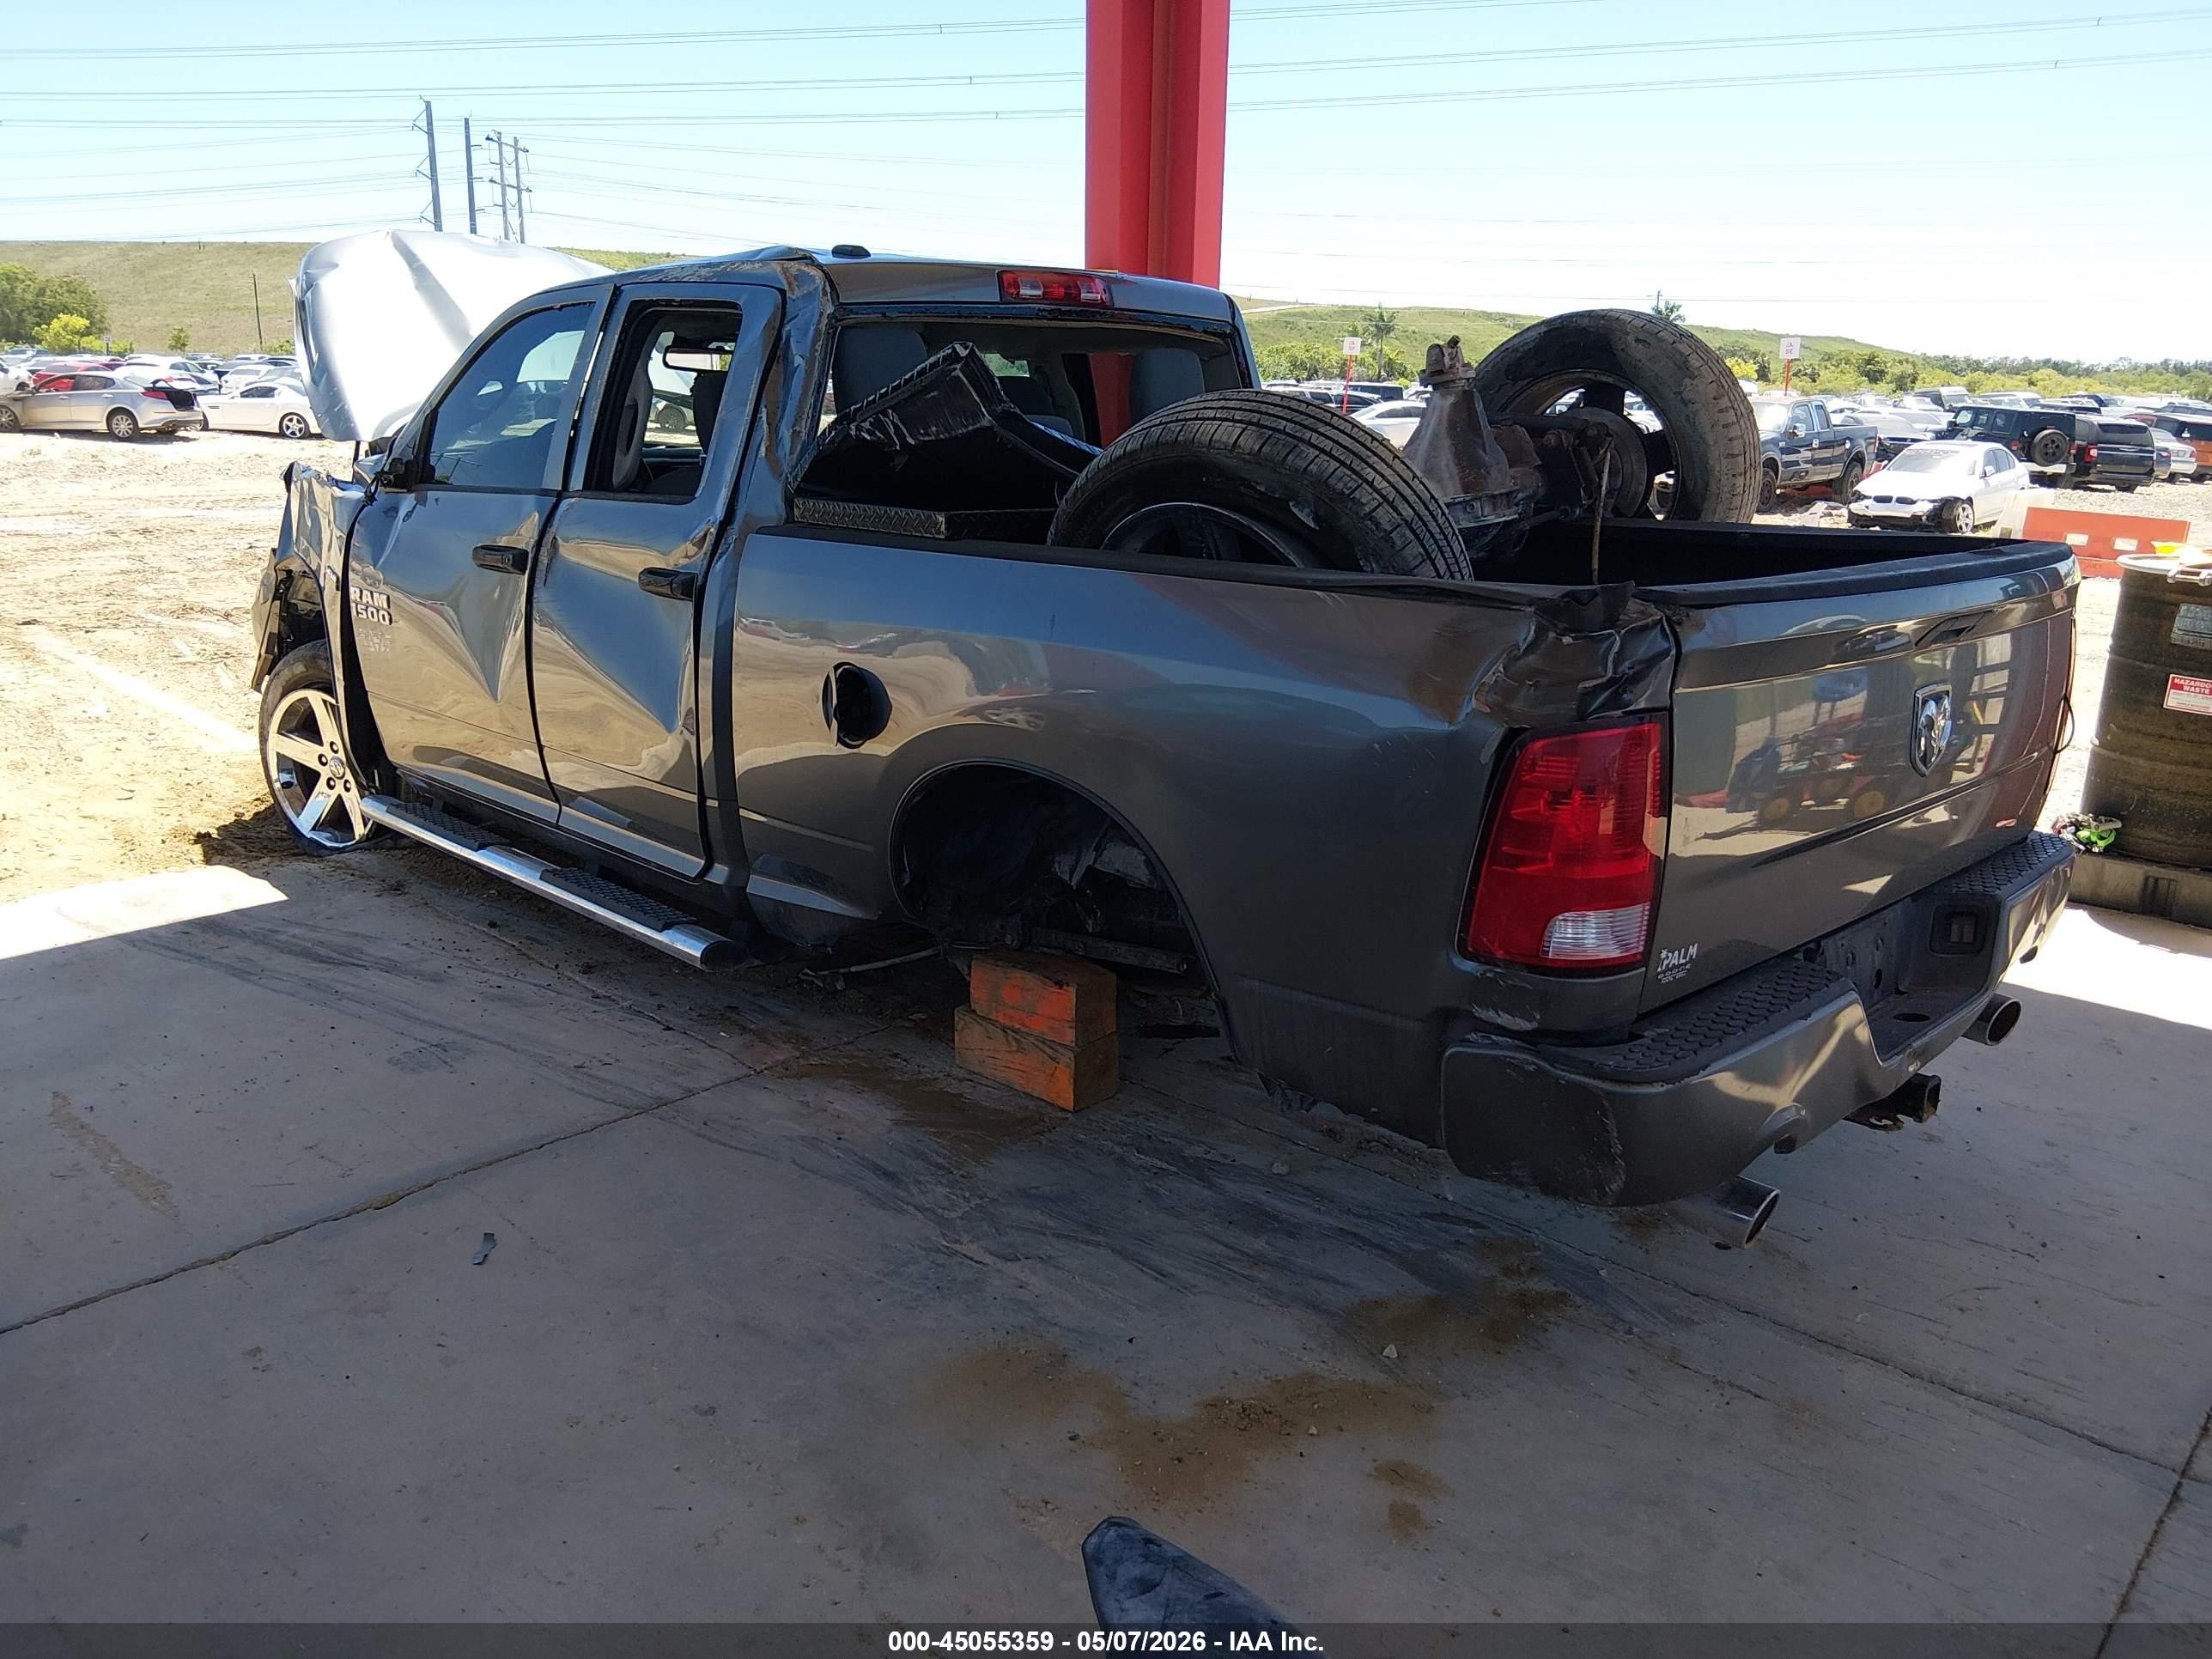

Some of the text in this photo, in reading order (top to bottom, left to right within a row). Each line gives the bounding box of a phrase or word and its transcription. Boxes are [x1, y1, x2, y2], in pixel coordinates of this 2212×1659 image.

[350, 585, 391, 610] RAM
[350, 602, 393, 626] 1500
[2173, 678, 2212, 689] HAZARDO
[2183, 684, 2210, 695] WASTE
[1662, 943, 1698, 970] PALM
